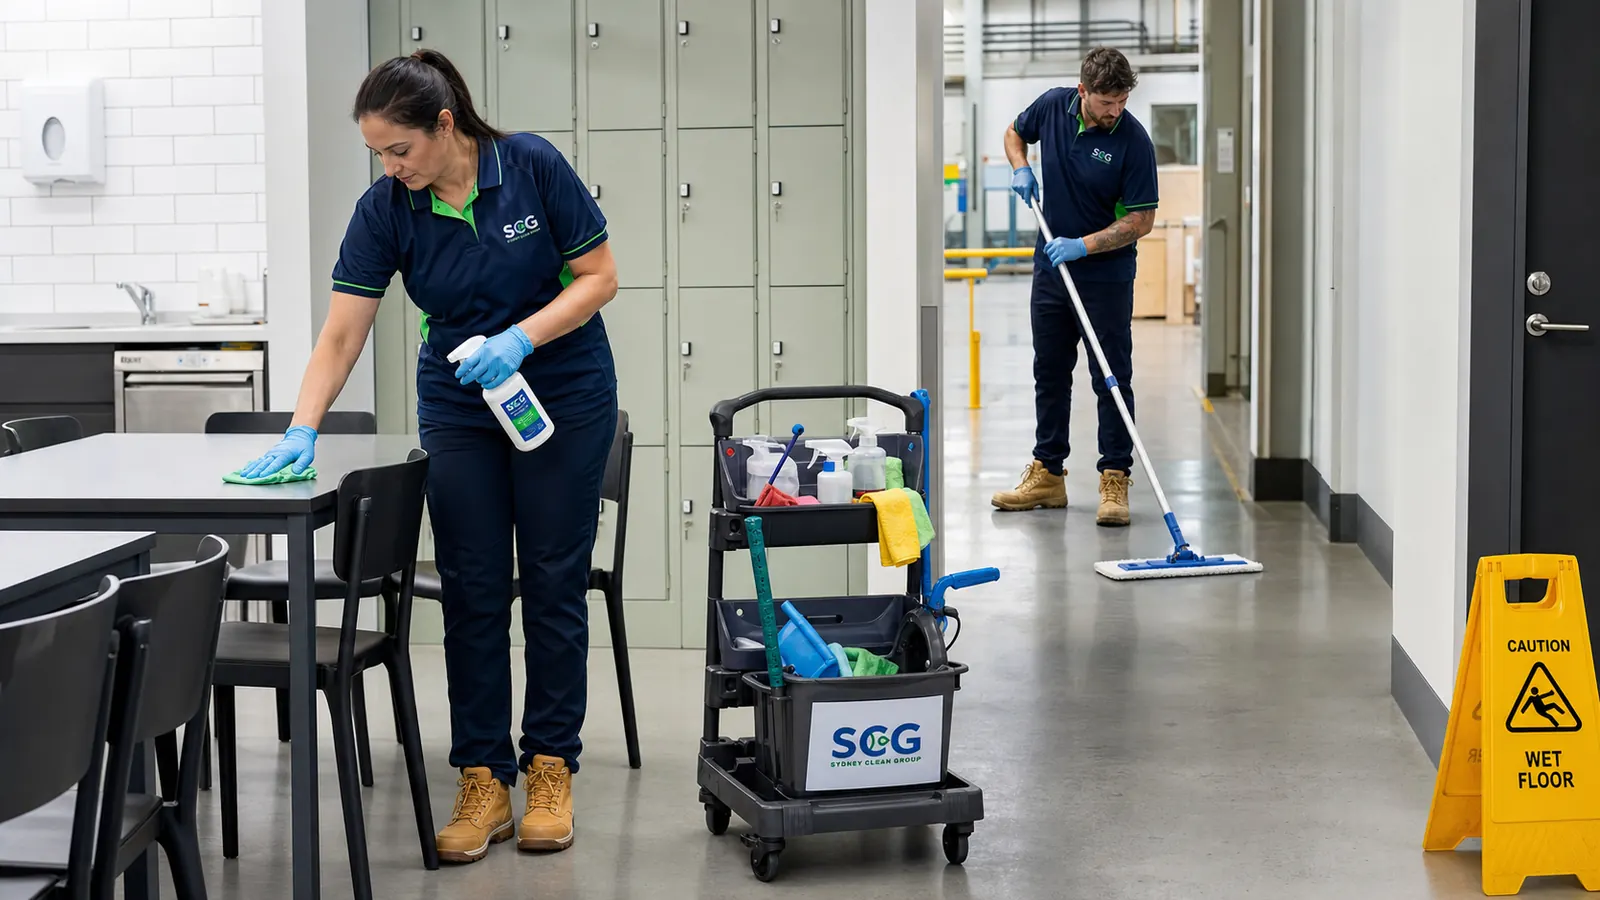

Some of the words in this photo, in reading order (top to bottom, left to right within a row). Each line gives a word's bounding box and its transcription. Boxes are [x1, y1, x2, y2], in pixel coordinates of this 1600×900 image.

[1092, 148, 1112, 162] SCG
[503, 215, 539, 239] SCG
[1507, 639, 1570, 652] CAUTION
[831, 722, 922, 759] SCG
[830, 760, 863, 768] SYDNEY
[864, 758, 892, 766] CLEAN
[893, 756, 922, 764] GROUP
[1525, 750, 1562, 768] WET
[1518, 771, 1575, 789] FLOOR
